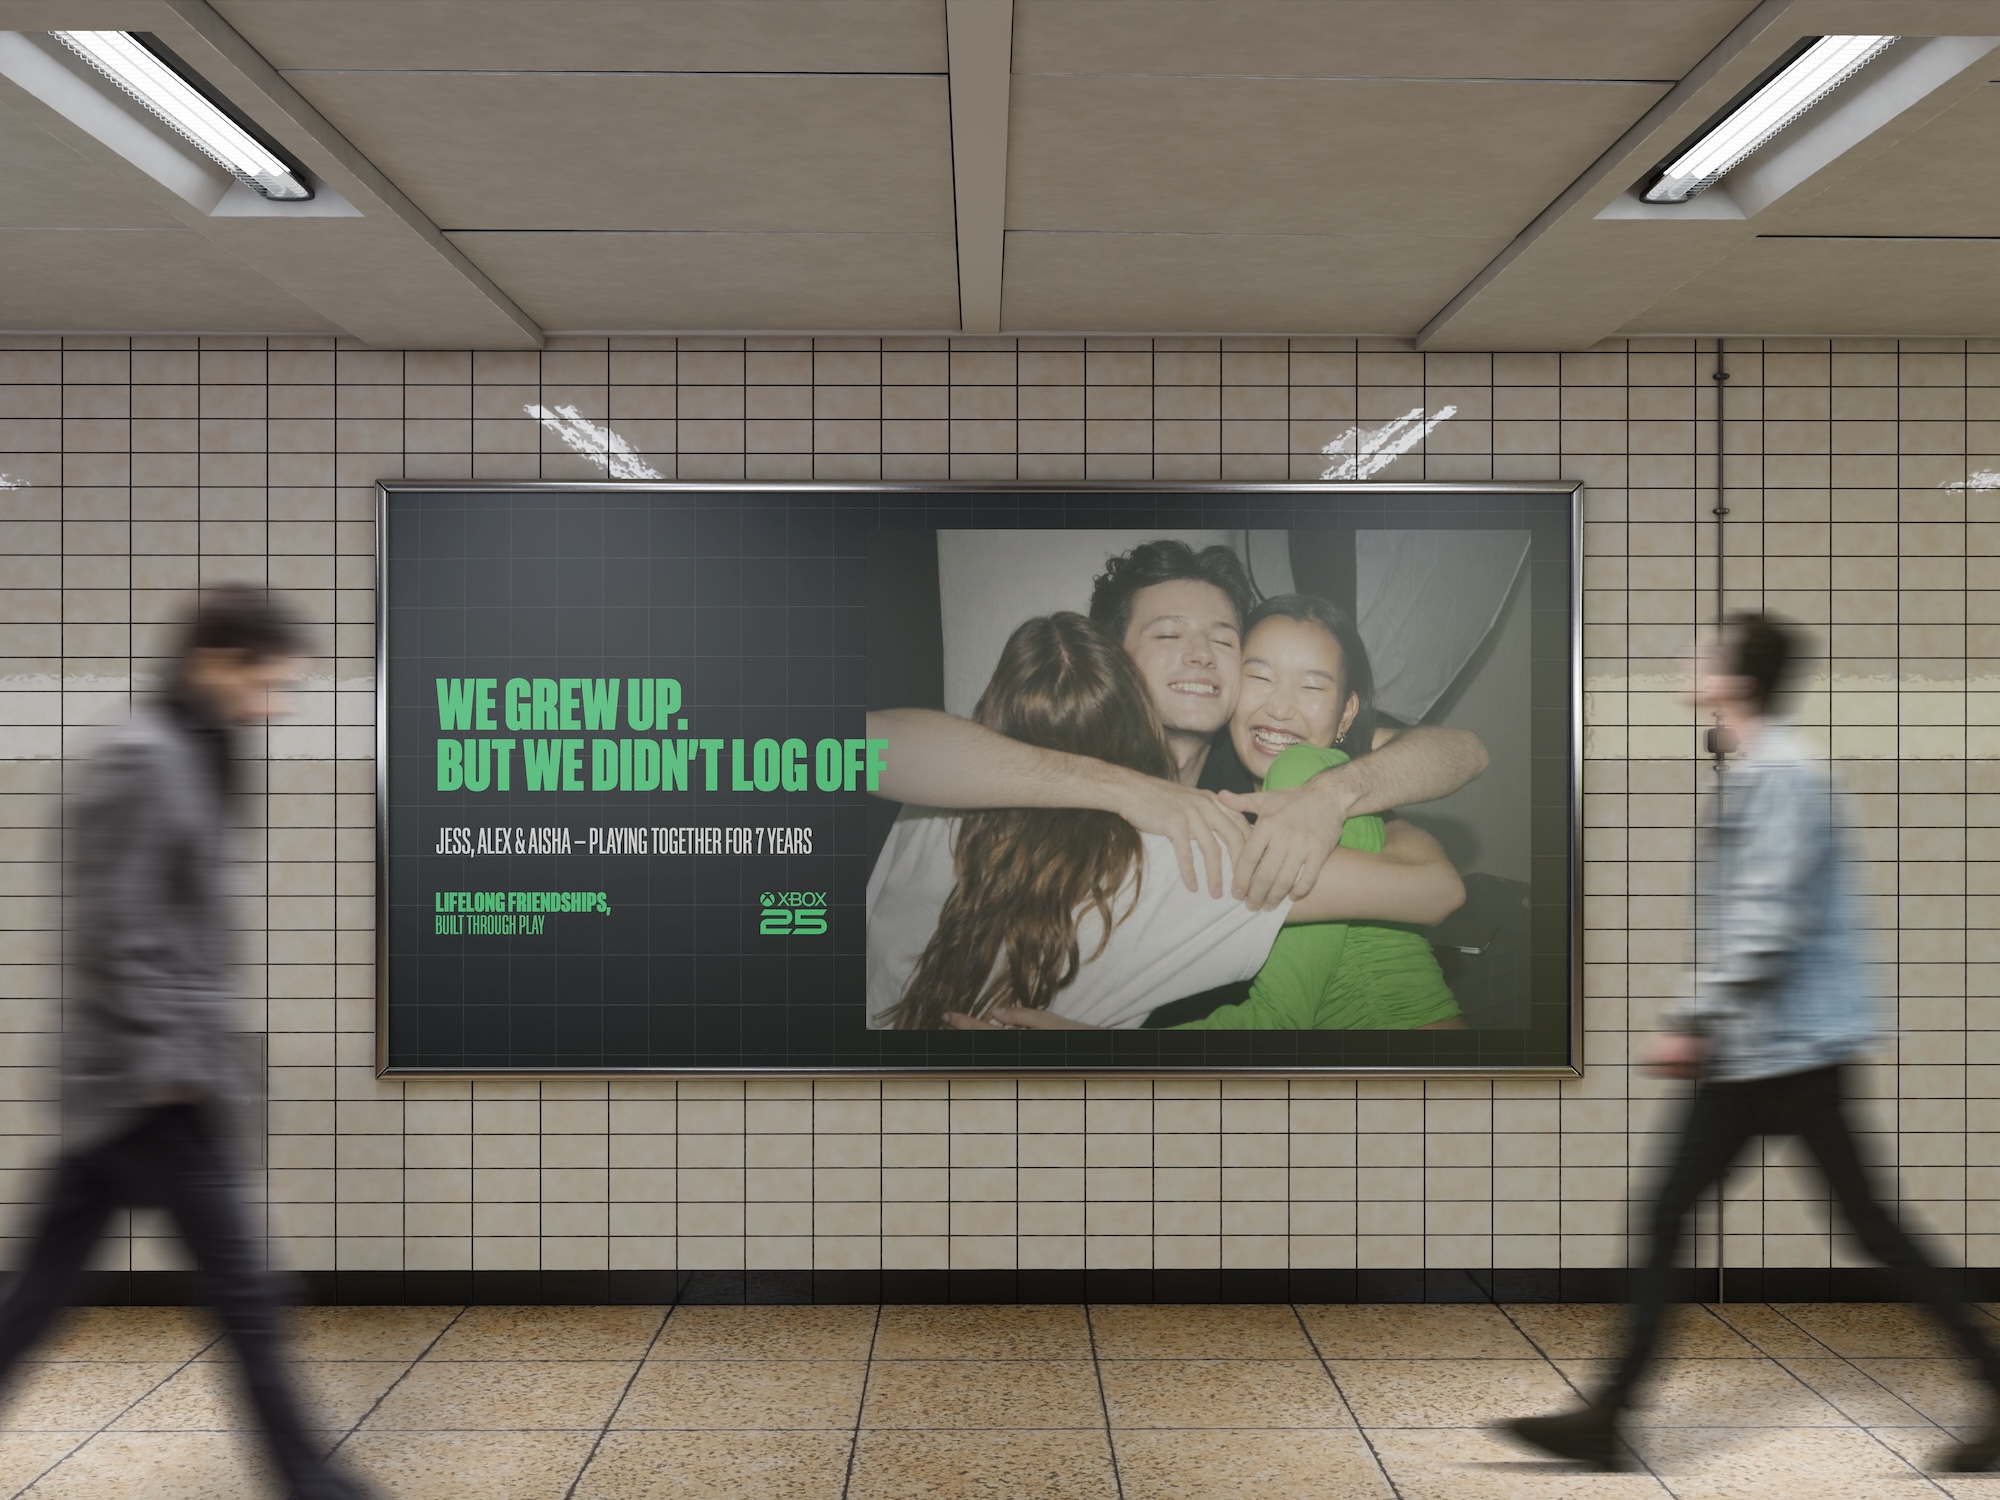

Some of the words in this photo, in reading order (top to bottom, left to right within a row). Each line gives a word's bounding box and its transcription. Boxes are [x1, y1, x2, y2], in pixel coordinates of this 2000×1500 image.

[436, 678, 497, 731] WE
[505, 677, 621, 731] GREW
[627, 678, 689, 731] UP.
[437, 738, 517, 792] BUT
[523, 738, 585, 791] WE
[731, 738, 808, 792] LOG
[815, 738, 889, 792] OFF
[435, 827, 475, 859] JESS,
[476, 827, 513, 855] ALEX
[514, 827, 526, 855] &
[528, 827, 572, 855] AISHA
[589, 827, 648, 855] PLAYING
[650, 827, 722, 855] TOGETHER
[725, 827, 753, 855] FOR
[755, 827, 765, 855] 7
[766, 827, 813, 855] YEARS
[435, 891, 506, 913] LIFELONG
[507, 891, 612, 916] FRIENDSHIPS,
[777, 891, 827, 907] XBOX
[435, 915, 464, 935] BUILT
[466, 915, 517, 935] THROUGH
[519, 915, 545, 935] PLAY
[759, 908, 828, 935] 25
